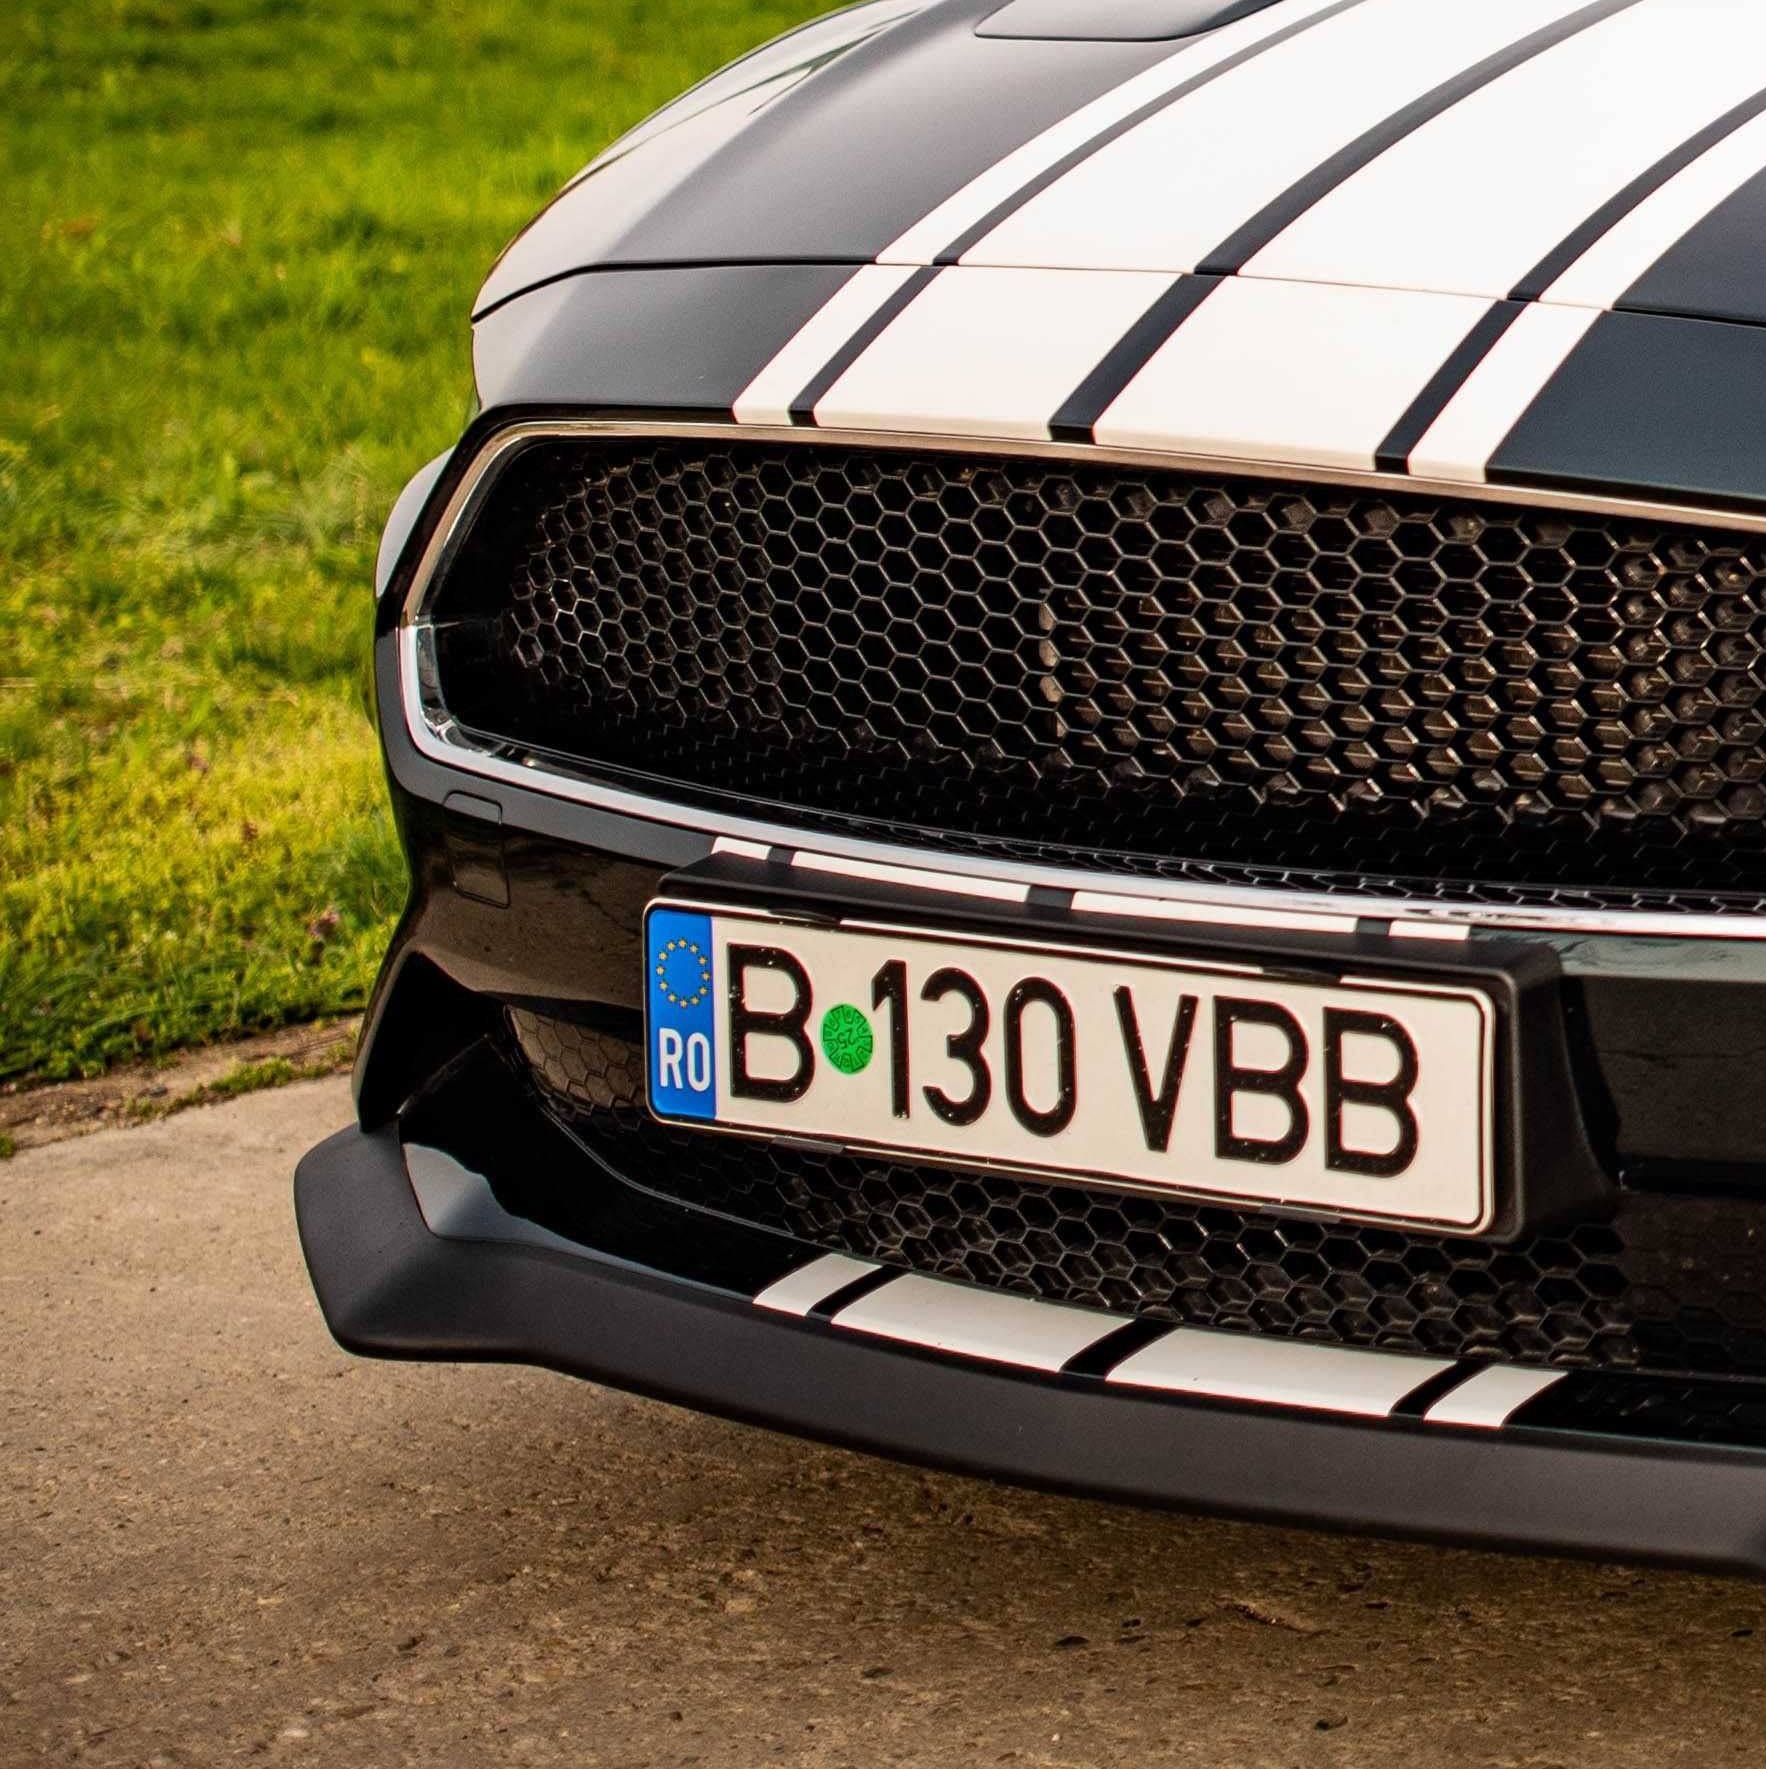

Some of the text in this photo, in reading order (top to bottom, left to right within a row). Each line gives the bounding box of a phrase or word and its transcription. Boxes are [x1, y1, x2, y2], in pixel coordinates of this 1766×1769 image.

[659, 1028, 711, 1091] RO
[727, 942, 1419, 1178] B 130 VBB
